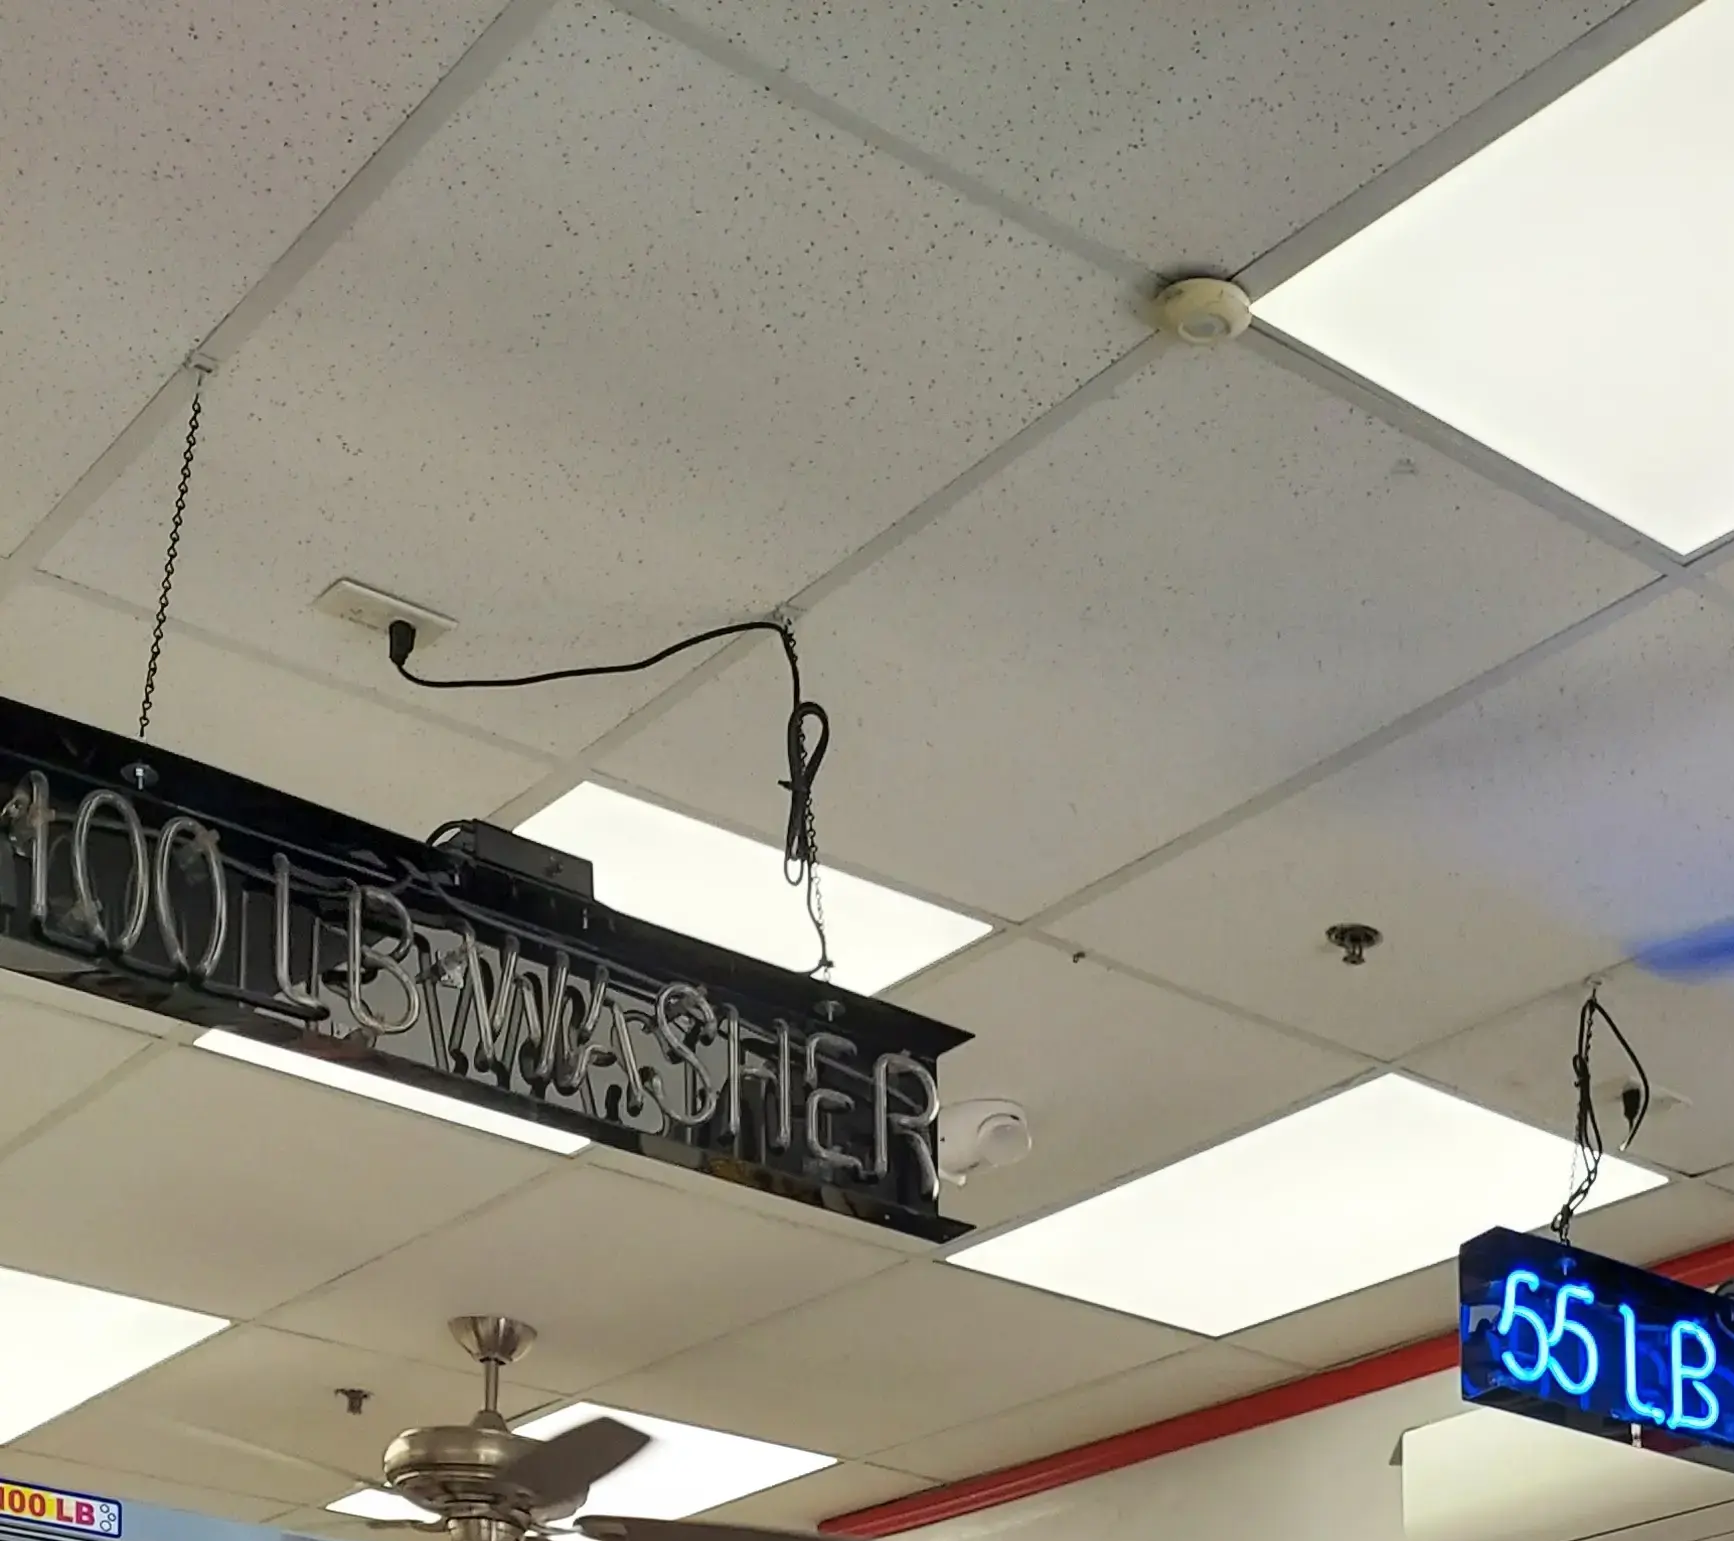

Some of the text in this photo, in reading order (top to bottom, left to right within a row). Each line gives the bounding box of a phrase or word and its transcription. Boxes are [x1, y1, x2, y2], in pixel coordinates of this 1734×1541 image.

[272, 852, 420, 1035] LB
[456, 920, 940, 1200] WASHER
[1499, 1270, 1598, 1394] 55
[1619, 1303, 1719, 1428] LB
[56, 1497, 95, 1526] LB
